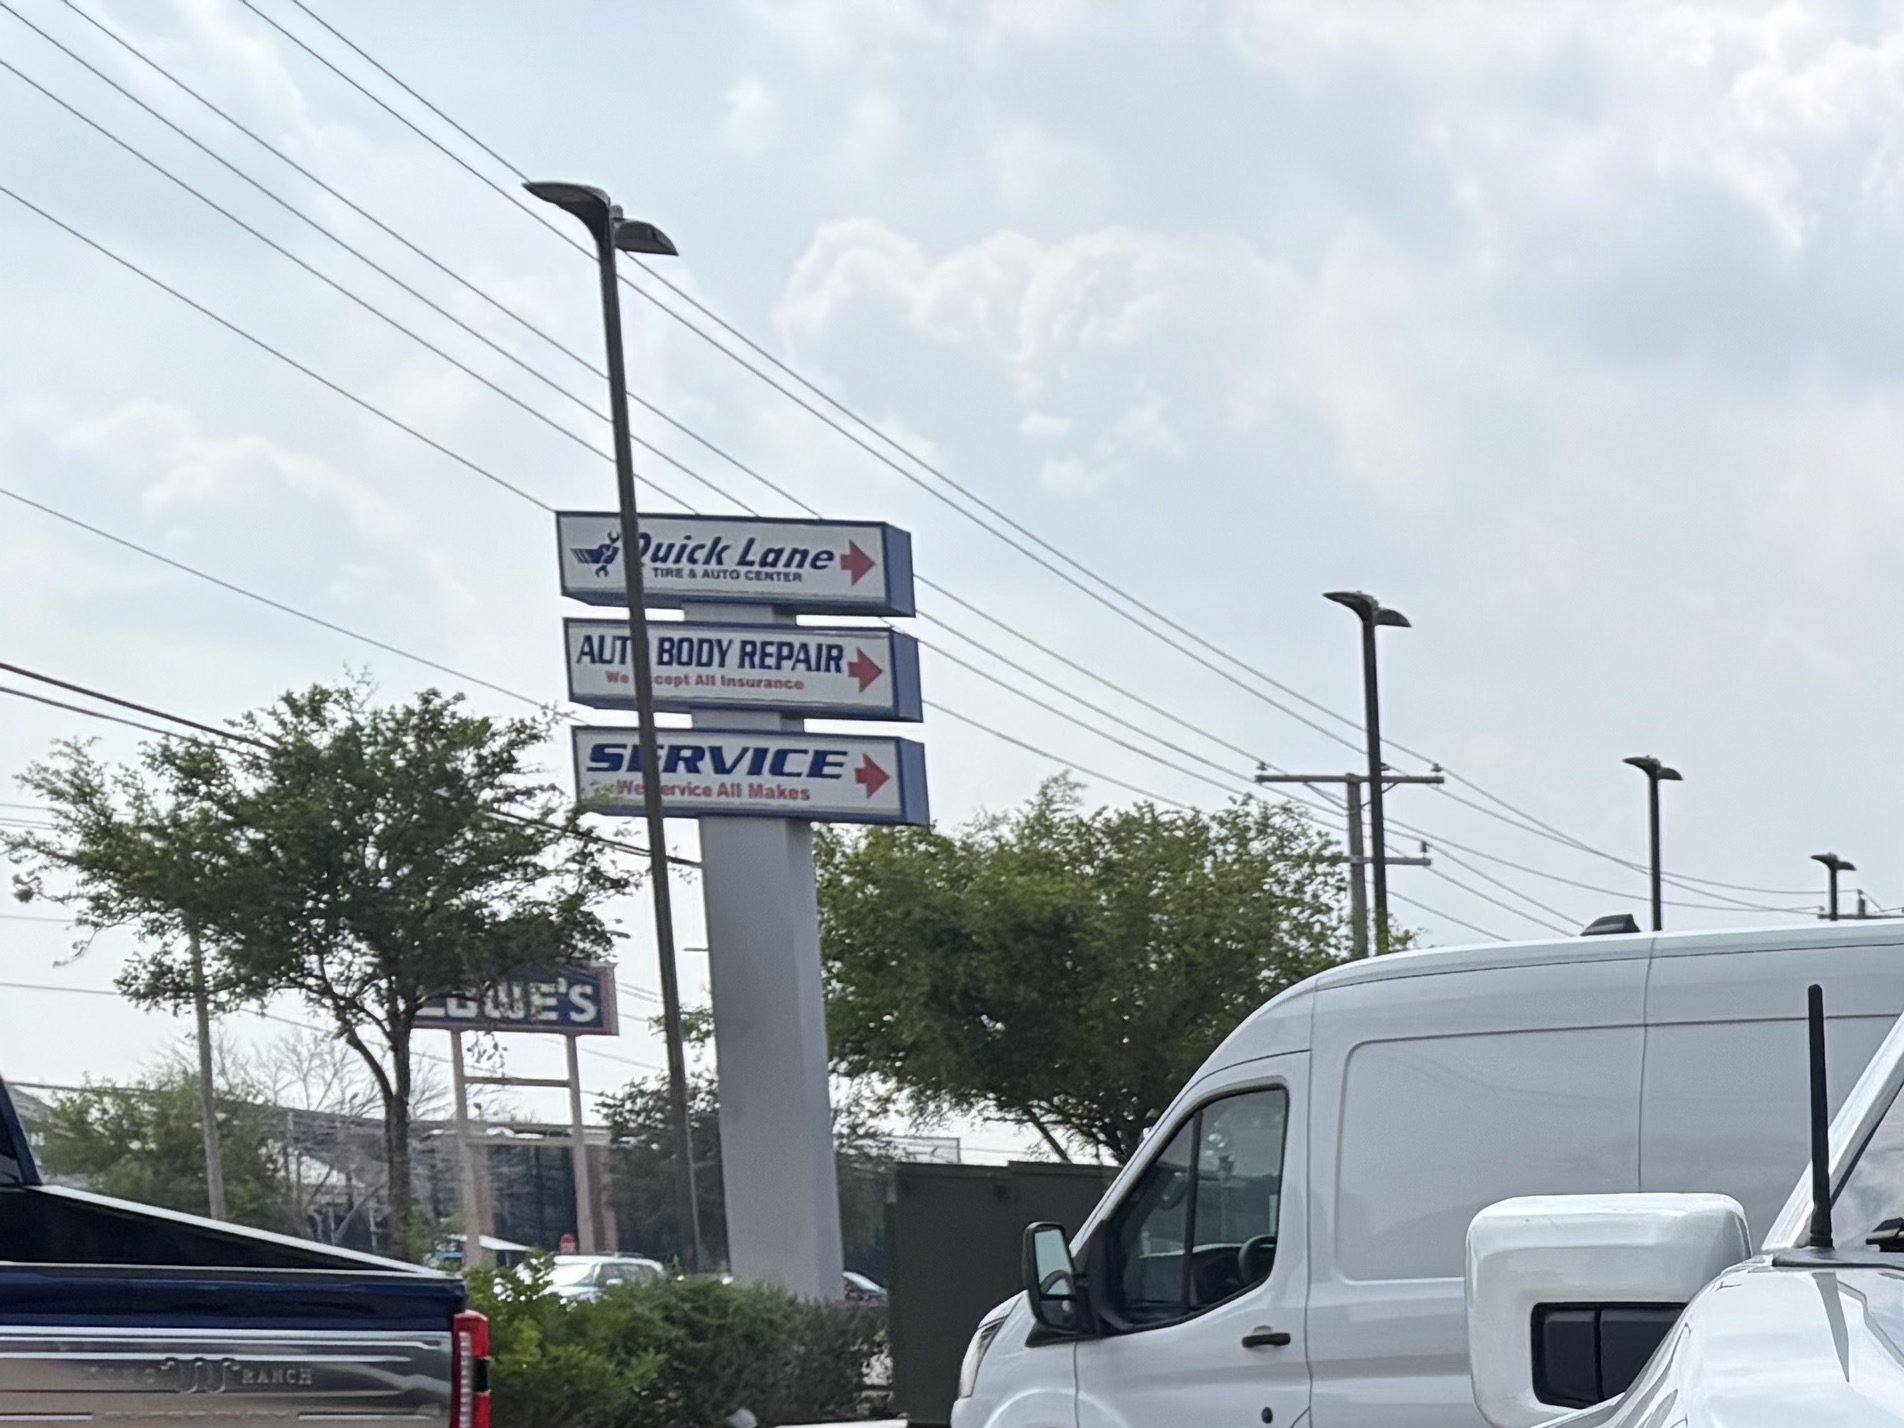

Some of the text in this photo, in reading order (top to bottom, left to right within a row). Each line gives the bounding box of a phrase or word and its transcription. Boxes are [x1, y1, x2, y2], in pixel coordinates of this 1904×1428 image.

[736, 537, 835, 570] Lane
[653, 567, 803, 583] TIRE & AUTO CENTER
[576, 634, 845, 674] AUT BODY REPAIR
[605, 671, 805, 691] We cept All Insurance
[616, 779, 811, 802] We ervice All Makes
[415, 976, 599, 1023] OWE'S
[242, 1367, 313, 1386] RANCH
